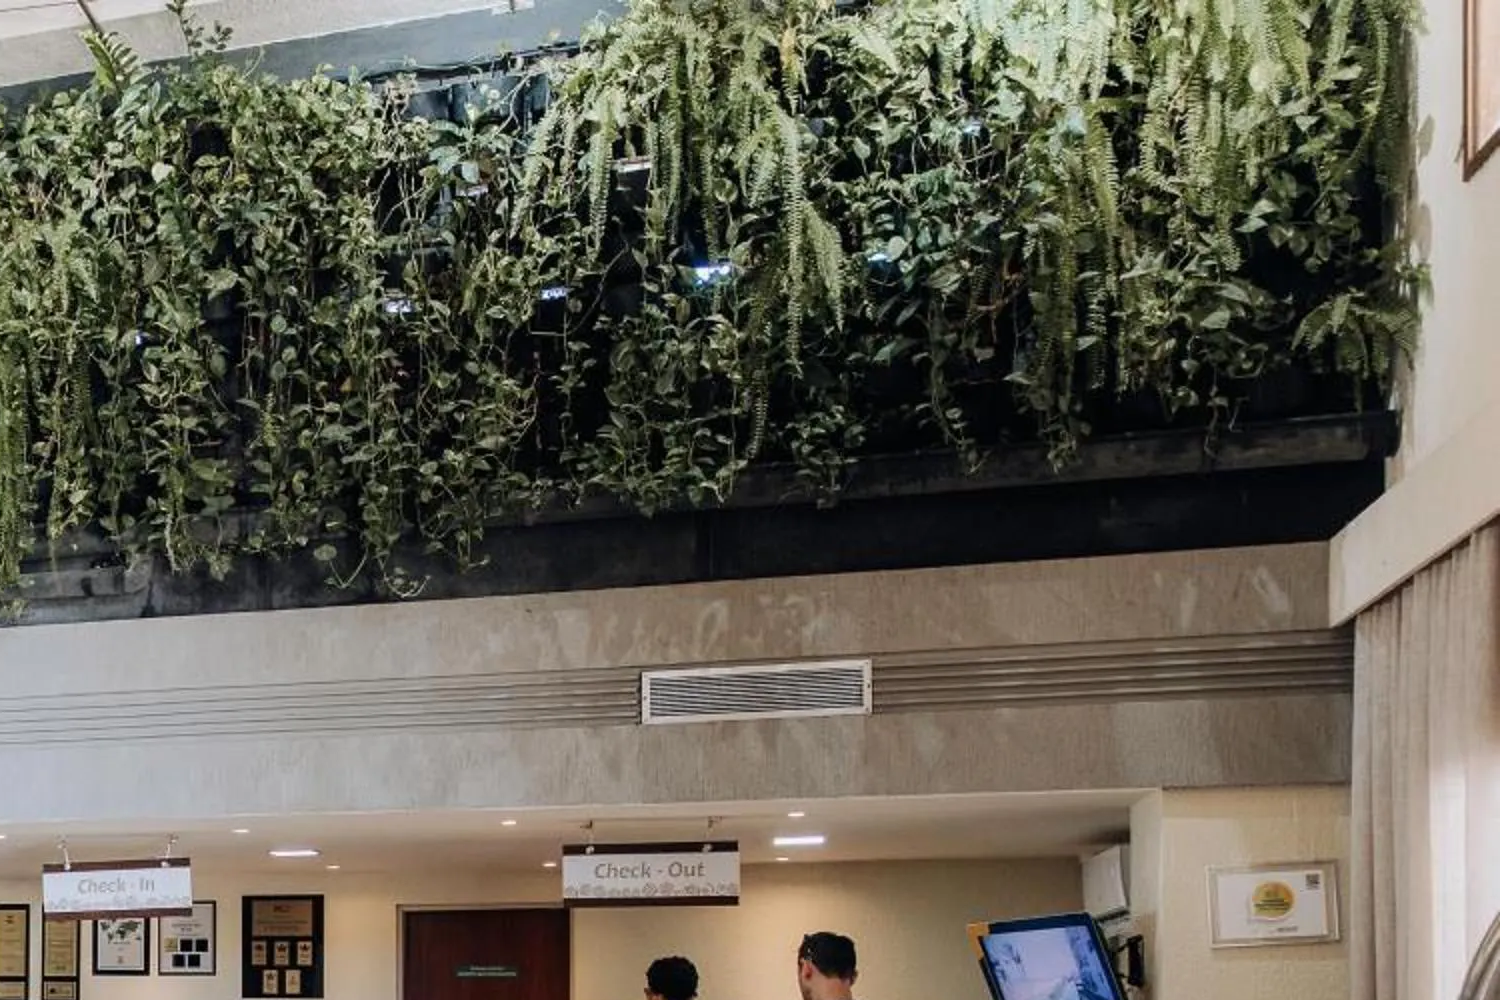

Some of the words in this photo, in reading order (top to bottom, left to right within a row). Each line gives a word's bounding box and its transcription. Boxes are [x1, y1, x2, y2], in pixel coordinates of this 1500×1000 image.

[594, 861, 651, 879] Check
[667, 860, 706, 878] Out
[77, 877, 126, 894] Check
